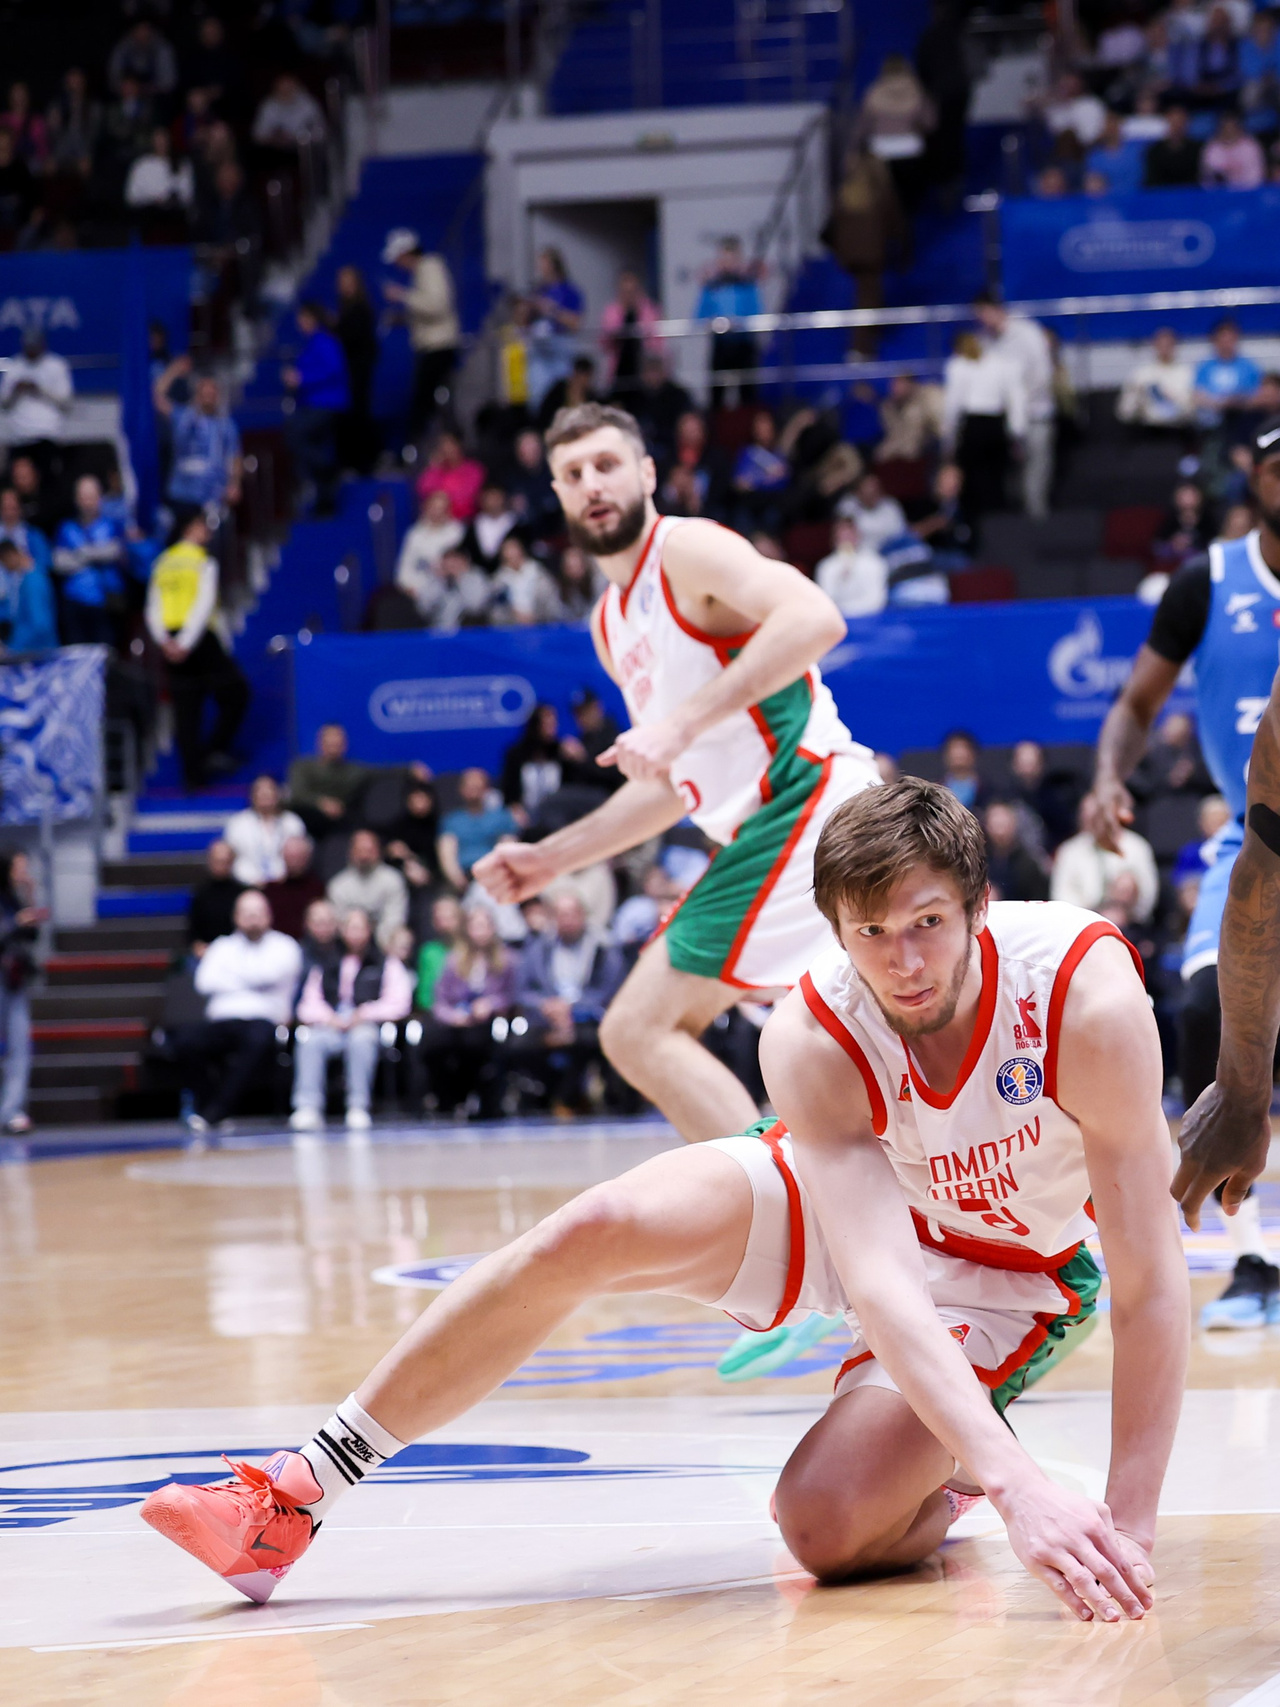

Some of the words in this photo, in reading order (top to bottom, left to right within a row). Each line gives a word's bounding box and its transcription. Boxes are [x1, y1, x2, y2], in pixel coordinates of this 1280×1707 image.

[929, 1115, 1041, 1184] OMOTIV
[926, 1162, 1019, 1201] UBAN
[350, 1439, 375, 1461] NIKE
